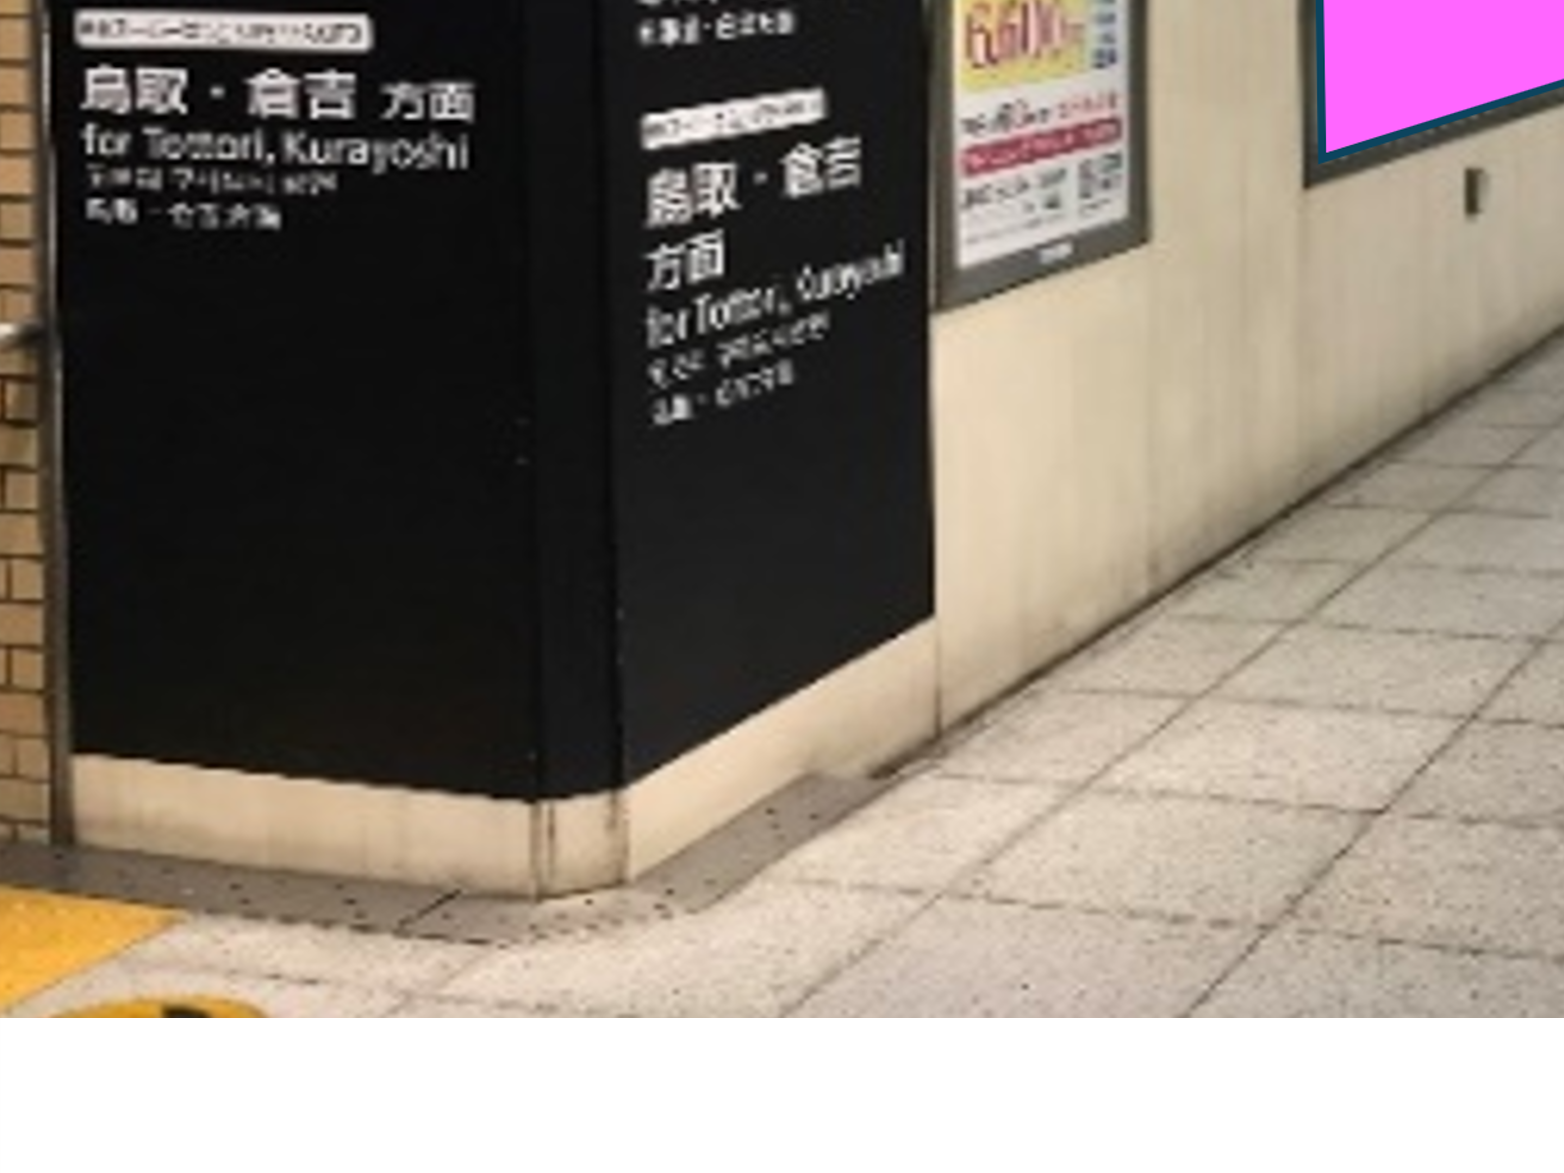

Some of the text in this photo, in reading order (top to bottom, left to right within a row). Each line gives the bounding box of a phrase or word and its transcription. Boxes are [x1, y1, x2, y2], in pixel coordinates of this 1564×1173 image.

[381, 81, 477, 122] 方面
[82, 122, 132, 156] for
[281, 131, 470, 175] Kurayoshi
[645, 229, 725, 292] 方面
